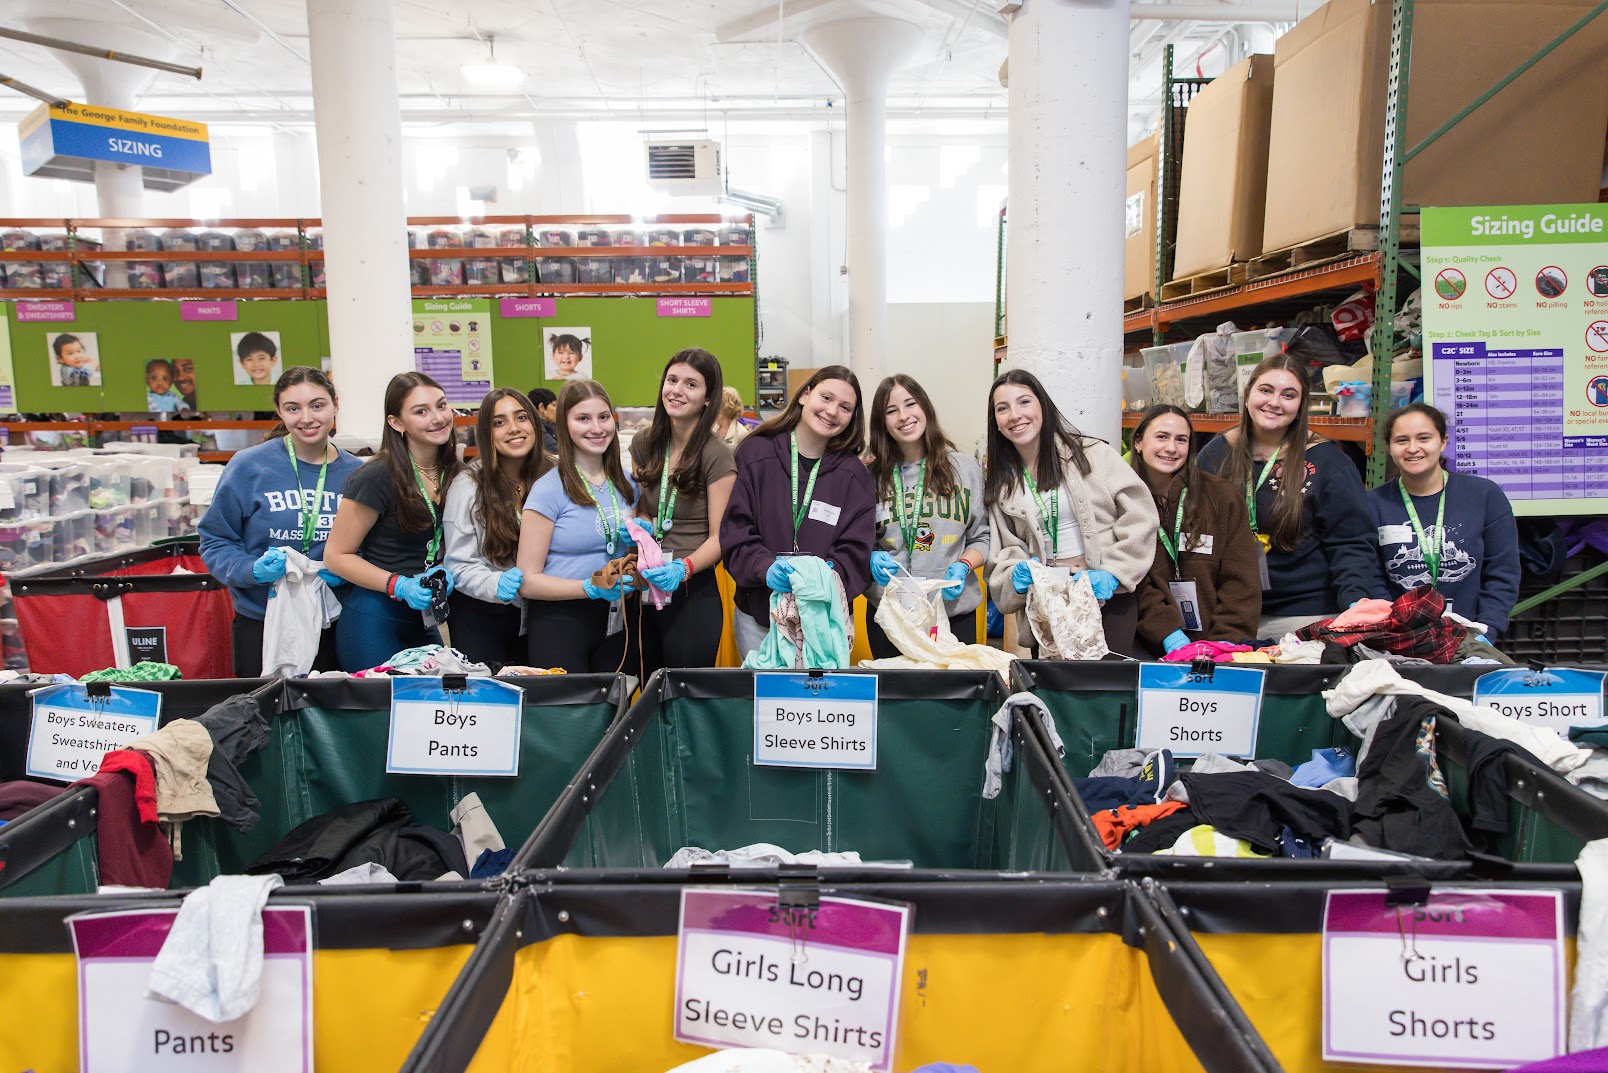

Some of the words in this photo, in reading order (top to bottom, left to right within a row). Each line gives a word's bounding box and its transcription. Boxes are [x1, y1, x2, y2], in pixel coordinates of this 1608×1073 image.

[62, 106, 78, 115] The
[81, 109, 116, 122] George
[119, 114, 148, 128] Family
[150, 120, 200, 134] Foundation
[108, 138, 162, 158] SIZING
[1471, 215, 1534, 239] Sizing
[1540, 214, 1603, 233] Guide
[1452, 255, 1478, 264] Quality
[198, 307, 221, 315] PANTS
[424, 303, 447, 311] Sizing
[450, 302, 472, 310] Guide
[1548, 301, 1568, 310] pilling
[1478, 330, 1491, 338] Tag
[1516, 329, 1525, 337] by
[880, 484, 971, 526] REGON
[269, 528, 330, 541] MASSCH
[132, 637, 158, 646] ULINE
[804, 679, 828, 690] Sort
[1179, 697, 1218, 716] Boys
[1538, 702, 1587, 716] Short
[47, 712, 75, 727] Boys
[78, 716, 140, 735] Sweaters,
[434, 710, 477, 729] Boys
[776, 708, 812, 725] Boys
[817, 709, 855, 726] Long
[765, 734, 816, 749] Sleeve
[821, 736, 866, 751] Shirts
[1170, 727, 1222, 741] Shorts
[428, 740, 478, 757] Pants
[56, 759, 78, 771] and
[82, 759, 101, 772] Ve
[768, 905, 817, 929] Sort
[712, 949, 779, 982] Girls
[790, 961, 863, 1001] Long
[1404, 956, 1478, 984] Girls
[685, 999, 783, 1034] Sleeve
[794, 1015, 882, 1049] Shirts
[1388, 1010, 1495, 1040] Shorts
[155, 1029, 234, 1054] Pants
